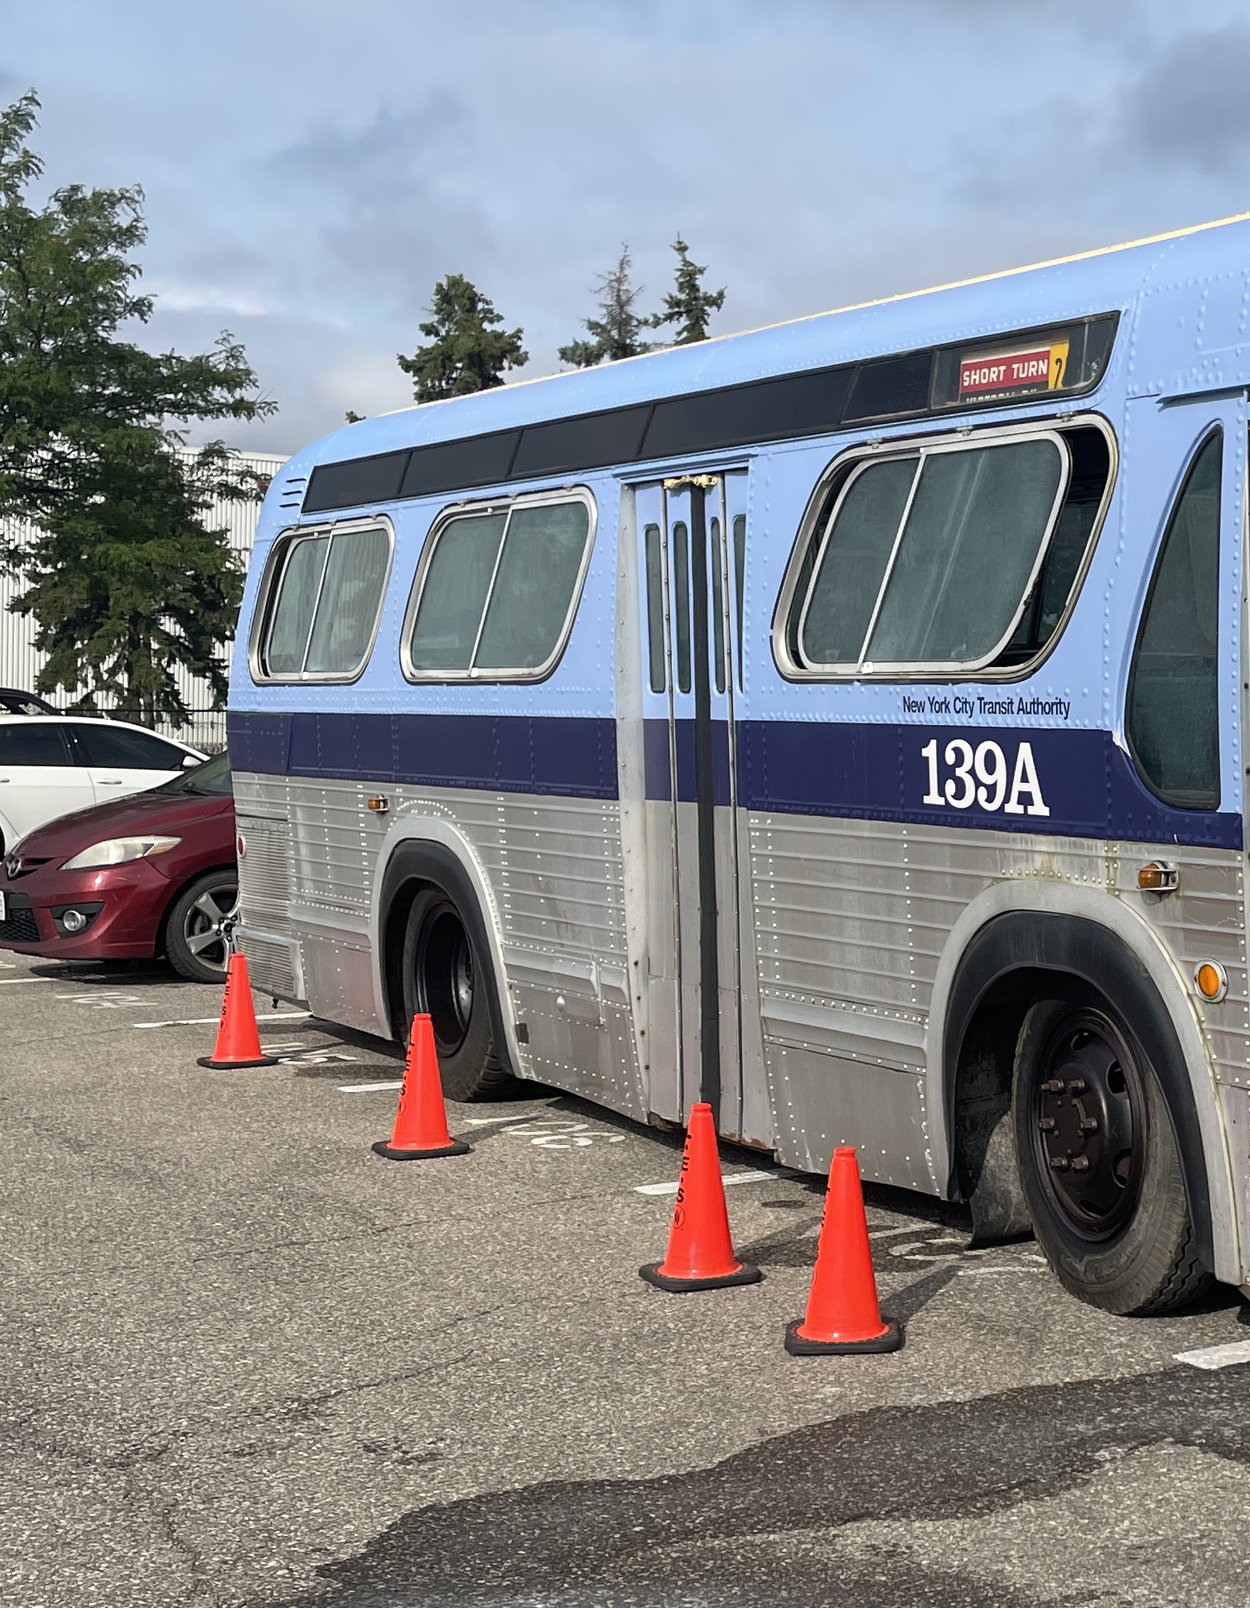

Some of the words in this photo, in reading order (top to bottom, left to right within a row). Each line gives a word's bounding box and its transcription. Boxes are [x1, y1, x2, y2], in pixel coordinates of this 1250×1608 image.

[962, 365, 1007, 387] SHORT
[1011, 358, 1048, 380] TURN
[902, 695, 926, 714] New
[927, 696, 950, 714] York
[953, 696, 975, 719] City
[977, 696, 1014, 715] Transit
[1016, 696, 1071, 720] Authority
[921, 738, 1050, 817] 139A
